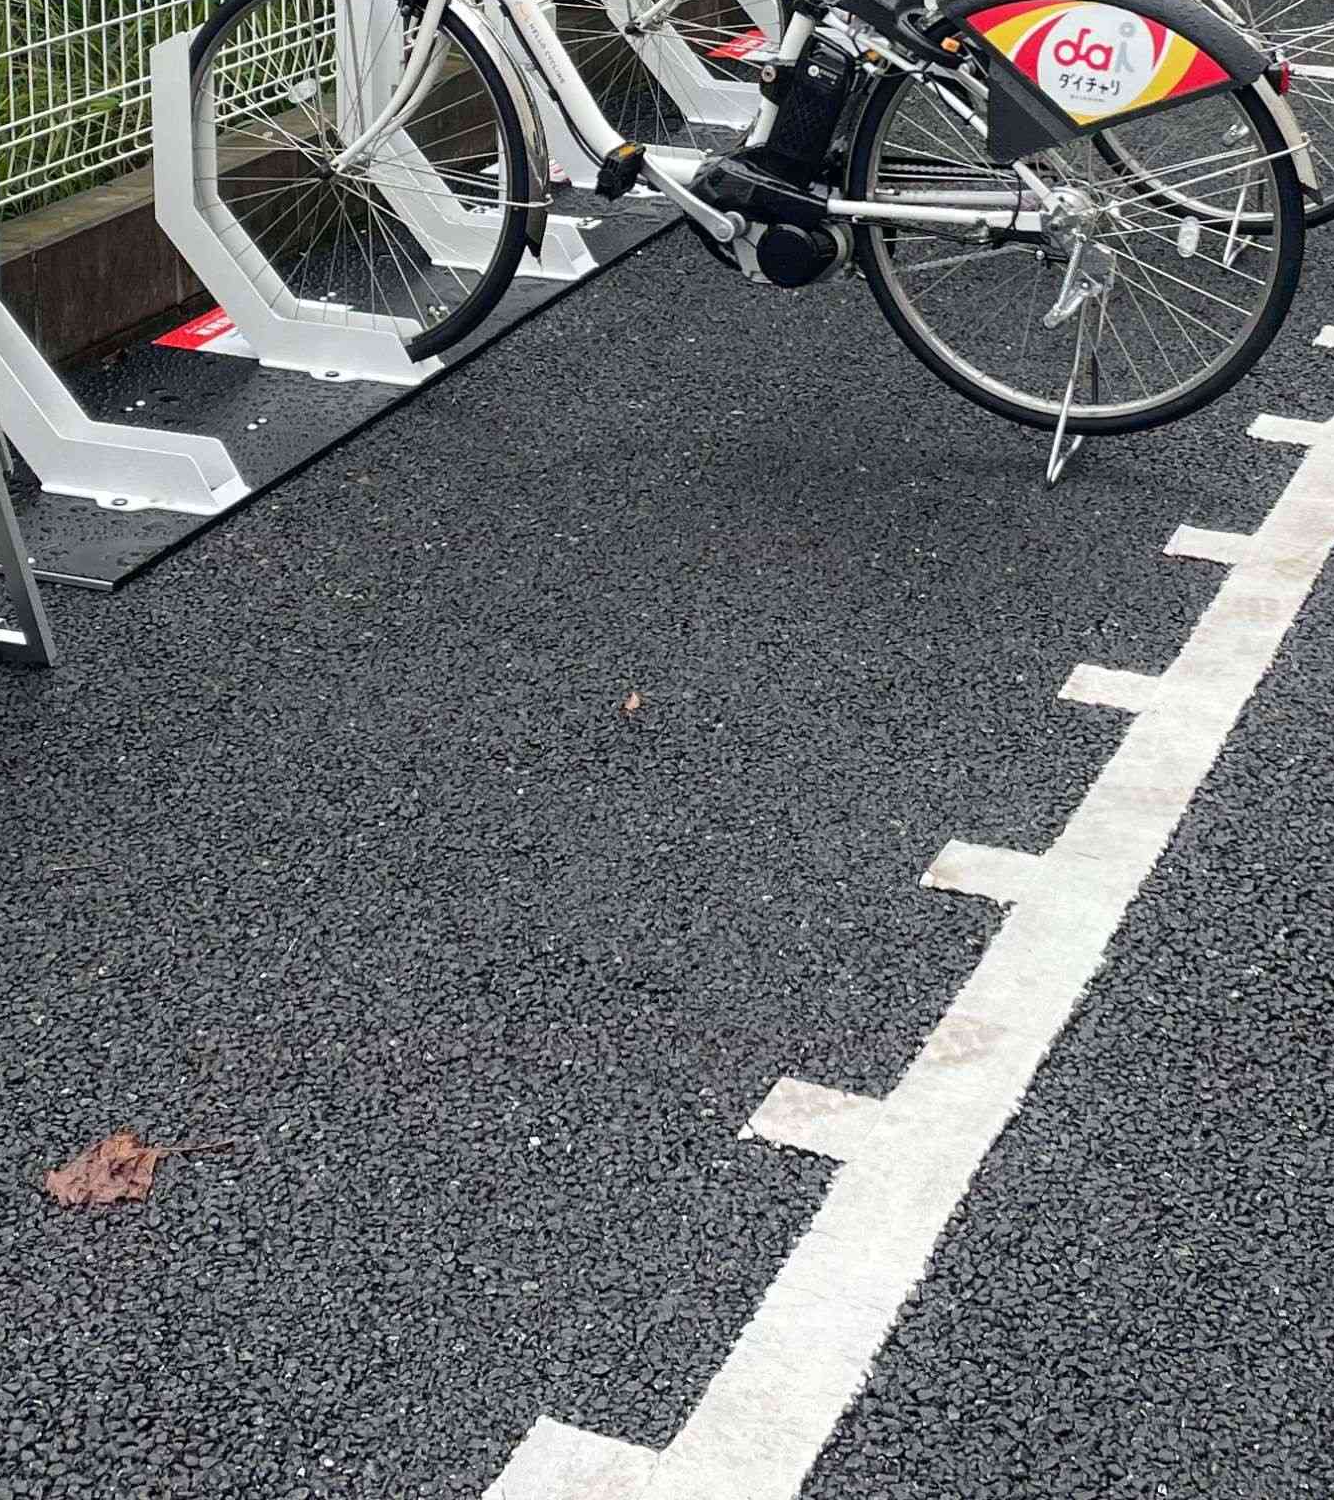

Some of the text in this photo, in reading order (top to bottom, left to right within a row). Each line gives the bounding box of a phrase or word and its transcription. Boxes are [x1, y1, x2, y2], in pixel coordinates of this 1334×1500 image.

[1058, 73, 1121, 96] ダイチャリ
